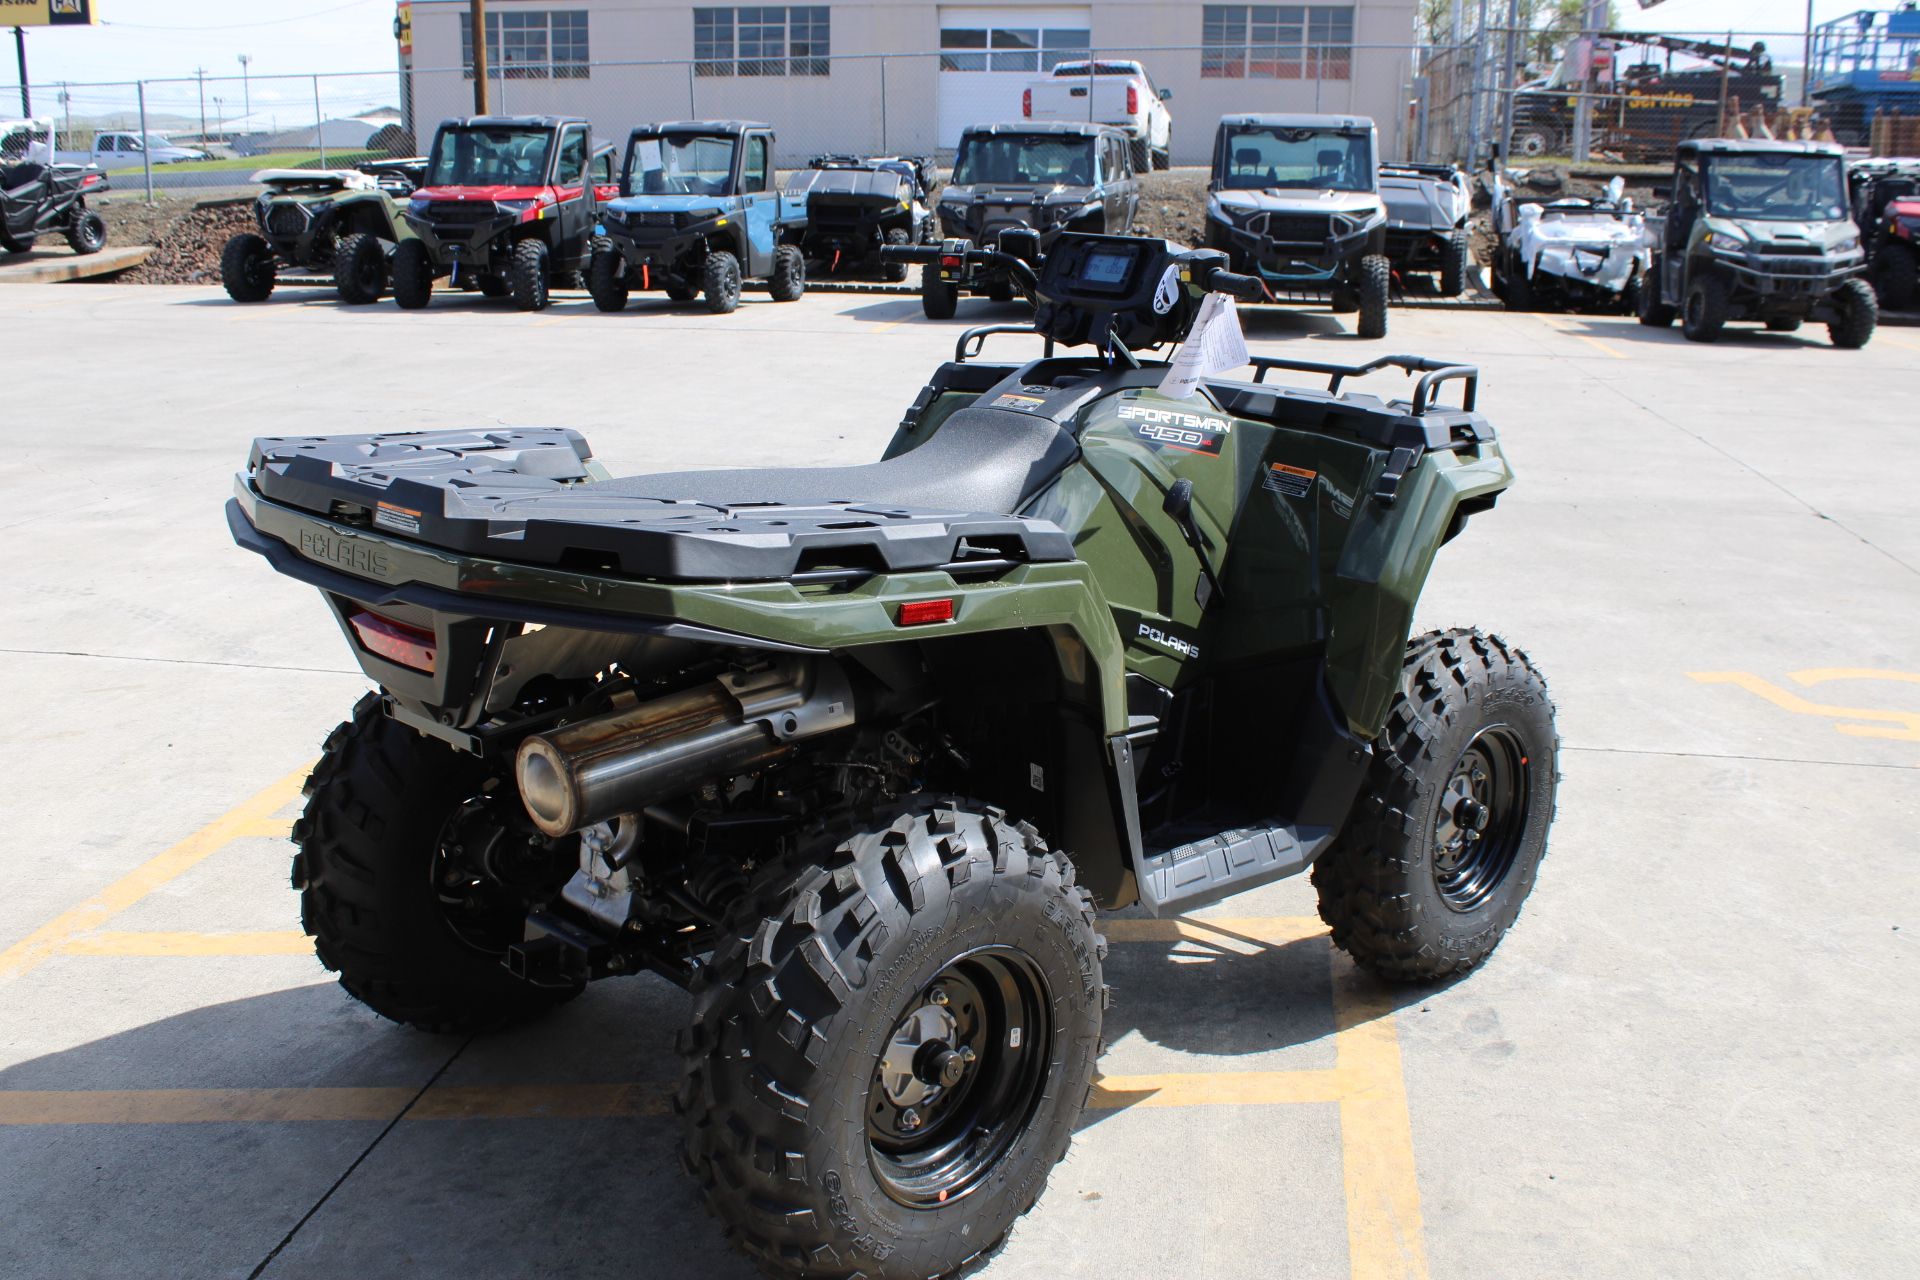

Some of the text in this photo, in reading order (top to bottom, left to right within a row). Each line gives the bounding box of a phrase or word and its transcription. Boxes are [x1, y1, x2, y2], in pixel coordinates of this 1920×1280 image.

[1629, 90, 1694, 109] Service
[1118, 406, 1232, 433] SPORTSMAN
[1139, 424, 1202, 446] 450
[300, 529, 389, 577] POLARIS
[1138, 623, 1200, 659] POLARIS
